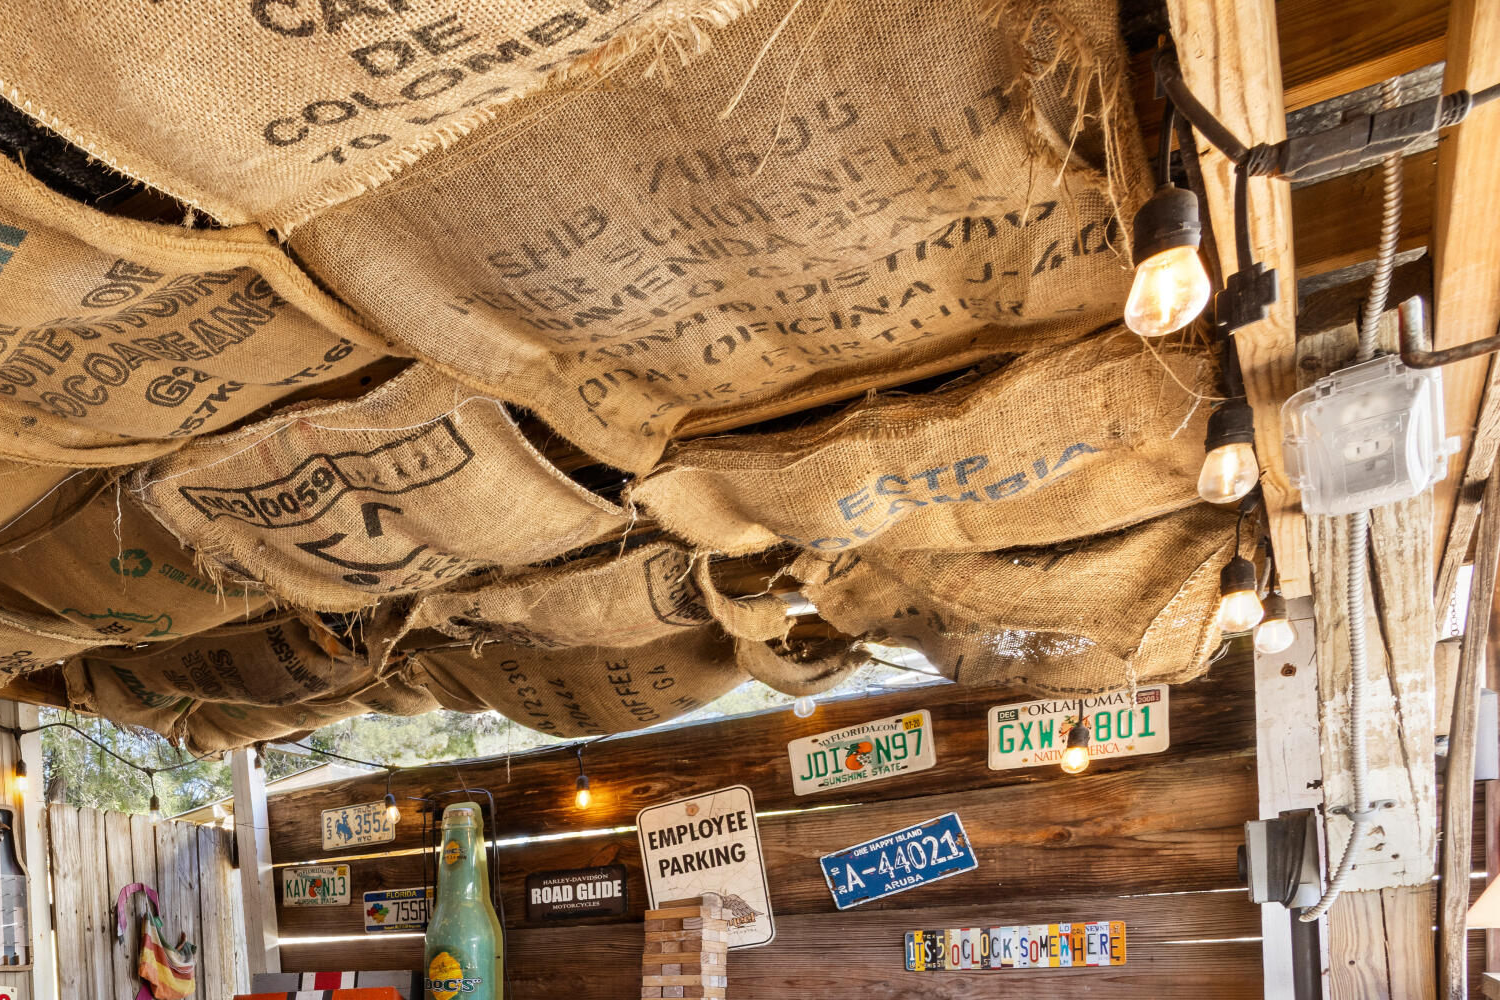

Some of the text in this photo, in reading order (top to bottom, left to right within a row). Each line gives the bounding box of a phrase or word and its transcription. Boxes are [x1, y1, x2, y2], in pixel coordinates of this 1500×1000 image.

[350, 15, 480, 78] DE
[263, 0, 617, 148] COLOMB
[260, 466, 336, 518] 0059
[605, 657, 661, 722] COFFEE
[999, 710, 1015, 719] DEC
[818, 723, 899, 748] MYFLORIDA.COM
[999, 706, 1156, 754] GXW 801
[800, 728, 923, 782] JDI N97
[1034, 748, 1066, 763] NATIV
[822, 763, 901, 787] SUNSHINE STATE
[648, 810, 749, 850] EMPLOYEE
[853, 828, 923, 857] ONE HAPPY ISLAND
[658, 843, 746, 878] PARKING
[531, 879, 622, 905] ROAD GLIDE
[543, 873, 609, 885] HARLEY-DAVIDSON
[884, 873, 924, 892] ARUBA
[386, 890, 417, 899] FLORIDA
[552, 900, 600, 910] MOTORCYCLES
[1020, 933, 1121, 963] SOMEWHERE
